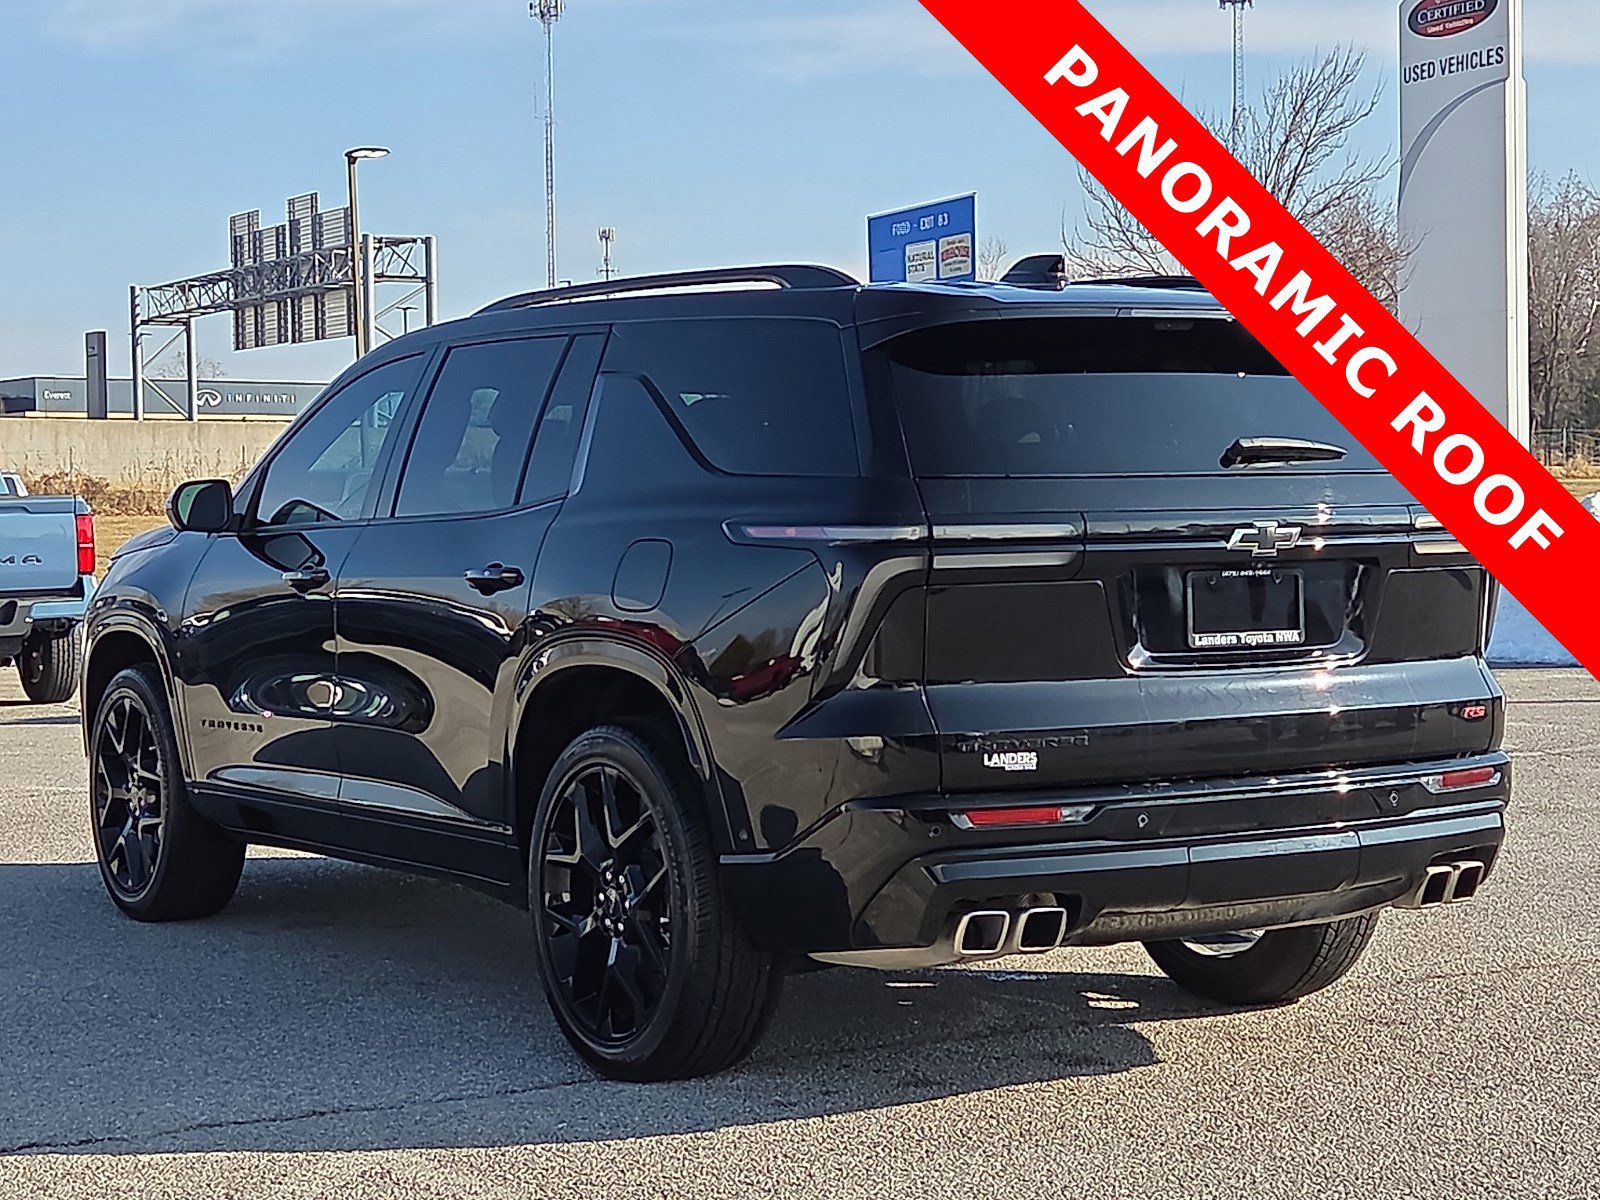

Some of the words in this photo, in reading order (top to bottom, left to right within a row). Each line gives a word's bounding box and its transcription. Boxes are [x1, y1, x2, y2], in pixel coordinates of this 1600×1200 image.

[1417, 0, 1485, 24] CERTIFIED
[1403, 61, 1436, 84] USED
[1439, 46, 1504, 76] VEHICLES
[891, 221, 911, 236] FOOD
[920, 215, 935, 231] EXIT
[907, 251, 935, 263] NATURAL
[227, 393, 296, 404] INFINITI
[1194, 634, 1238, 647] Landers
[1240, 633, 1275, 647] Toyota
[1275, 631, 1301, 644] NWA
[1461, 705, 1486, 719] RS
[984, 752, 1038, 767] LANDERS
